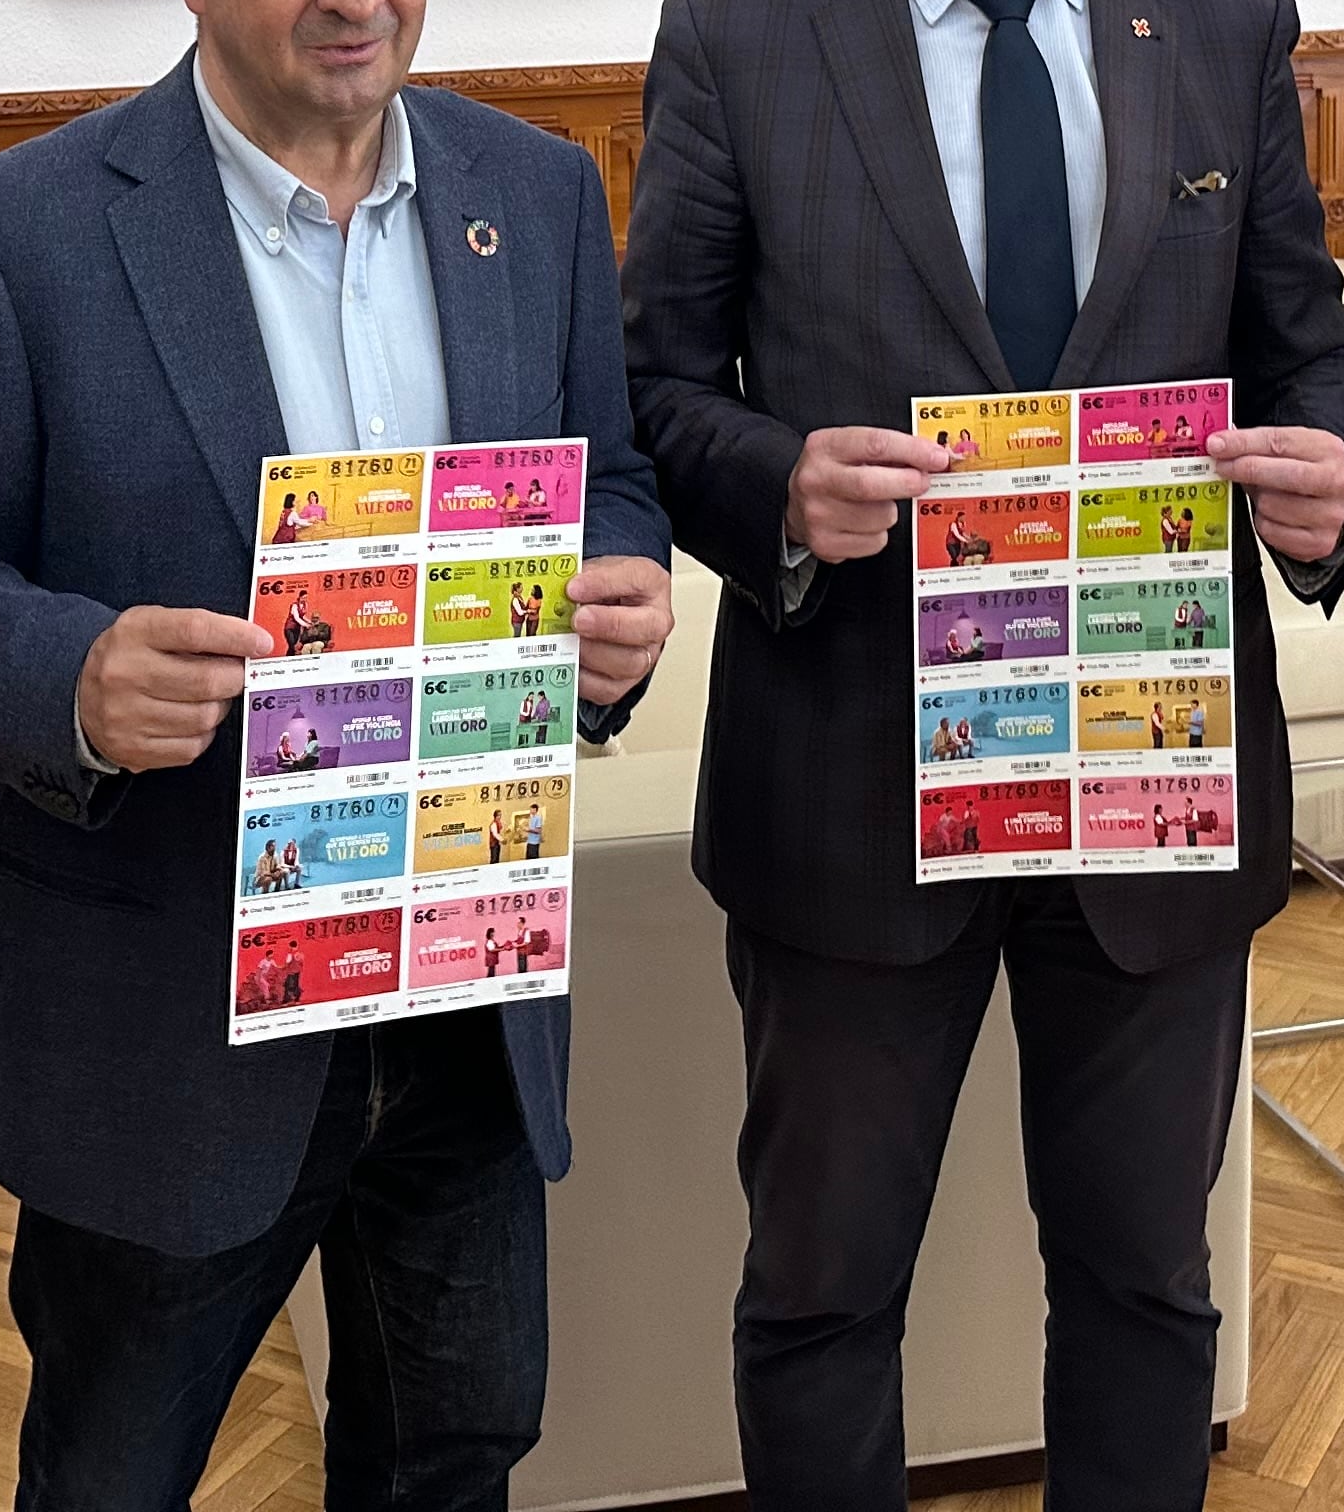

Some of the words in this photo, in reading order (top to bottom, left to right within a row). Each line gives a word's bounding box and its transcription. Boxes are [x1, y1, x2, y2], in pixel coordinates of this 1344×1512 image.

[1082, 397, 1104, 409] 6€
[1140, 389, 1197, 405] 81760
[920, 407, 942, 419] 6€
[980, 400, 1039, 416] 81760
[1036, 437, 1062, 447] ORO
[1117, 433, 1144, 445] ORO
[495, 450, 553, 467] 81760
[564, 450, 576, 459] 76
[331, 458, 393, 475] 81760
[405, 458, 416, 468] 71
[436, 456, 457, 470] 6€
[269, 466, 292, 481] 6€
[1081, 494, 1103, 506] 6€
[1139, 486, 1198, 502] 81760
[386, 500, 413, 512] ORO
[469, 497, 497, 510] ORO
[920, 503, 942, 515] 6€
[979, 497, 1039, 512] 81760
[490, 559, 548, 577] 81760
[560, 558, 571, 569] 77
[323, 570, 385, 589] 81760
[398, 569, 409, 580] 72
[429, 567, 452, 581] 6€
[259, 580, 284, 595] 6€
[1080, 589, 1101, 600] 6€
[1138, 582, 1197, 597] 81760
[921, 600, 942, 612] 6€
[378, 613, 408, 626] ORO
[464, 607, 492, 620] ORO
[1116, 622, 1143, 632] ORO
[485, 670, 544, 688] 81760
[556, 669, 567, 680] 78
[393, 683, 404, 695] 73
[424, 681, 447, 695] 6€
[1080, 685, 1102, 697] 6€
[1139, 679, 1198, 693] 81760
[316, 684, 380, 704] 81760
[979, 688, 1038, 704] 81760
[252, 696, 276, 711] 6€
[922, 697, 943, 709] 6€
[460, 719, 488, 732] ORO
[373, 727, 402, 741] ORO
[480, 781, 540, 800] 81760
[552, 780, 563, 791] 79
[1082, 782, 1104, 794] 6€
[1141, 778, 1200, 791] 81760
[419, 794, 442, 809] 6€
[923, 793, 944, 805] 6€
[311, 799, 375, 819] 81760
[246, 814, 271, 830] 6€
[360, 843, 389, 857] ORO
[475, 893, 536, 914] 81760
[414, 909, 437, 923] 6€
[306, 915, 369, 937] 81760
[241, 932, 265, 949] 6€
[449, 947, 477, 961] ORO
[362, 960, 392, 974] ORO
